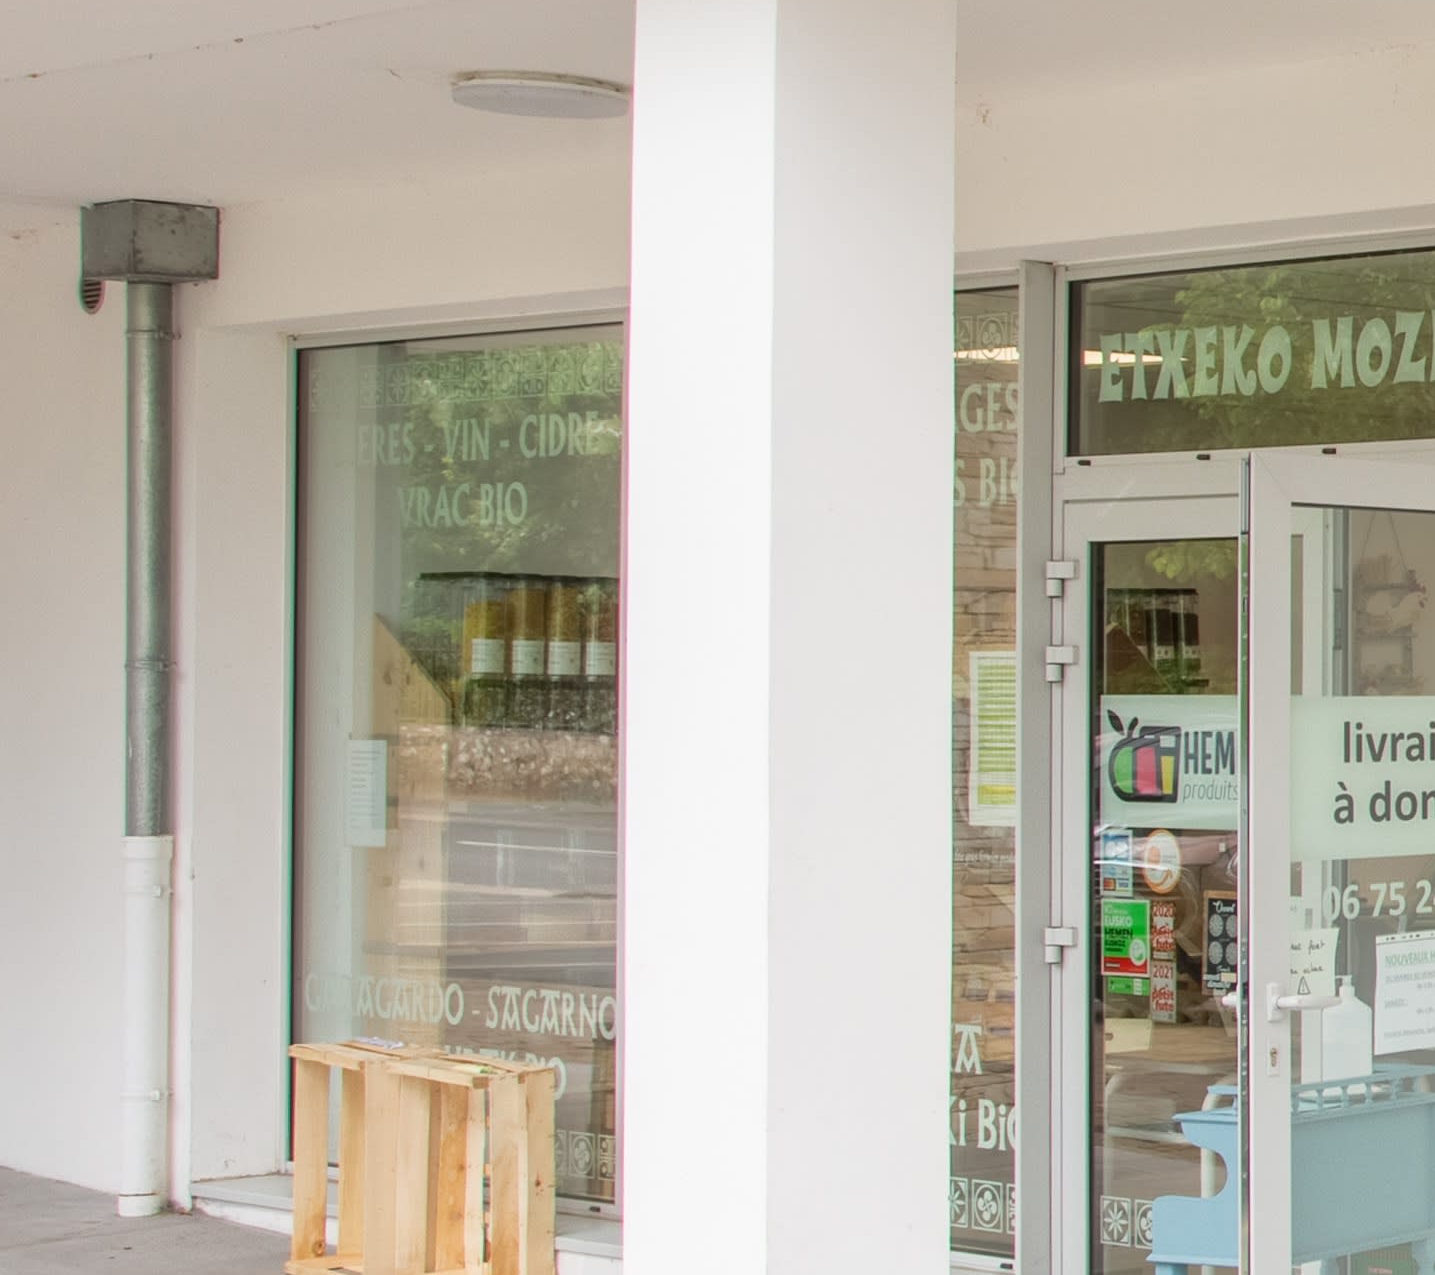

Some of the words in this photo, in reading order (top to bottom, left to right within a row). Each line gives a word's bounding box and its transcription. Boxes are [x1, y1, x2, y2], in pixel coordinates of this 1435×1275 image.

[1098, 325, 1293, 404] ETXEKO
[446, 419, 490, 461] VIN
[518, 411, 600, 460] CIDRE
[398, 483, 470, 527] VRAC
[479, 480, 528, 526] BIO
[1333, 782, 1355, 824] à
[1324, 884, 1360, 922] 06
[1370, 879, 1406, 917] 75
[1154, 964, 1174, 979] 2021
